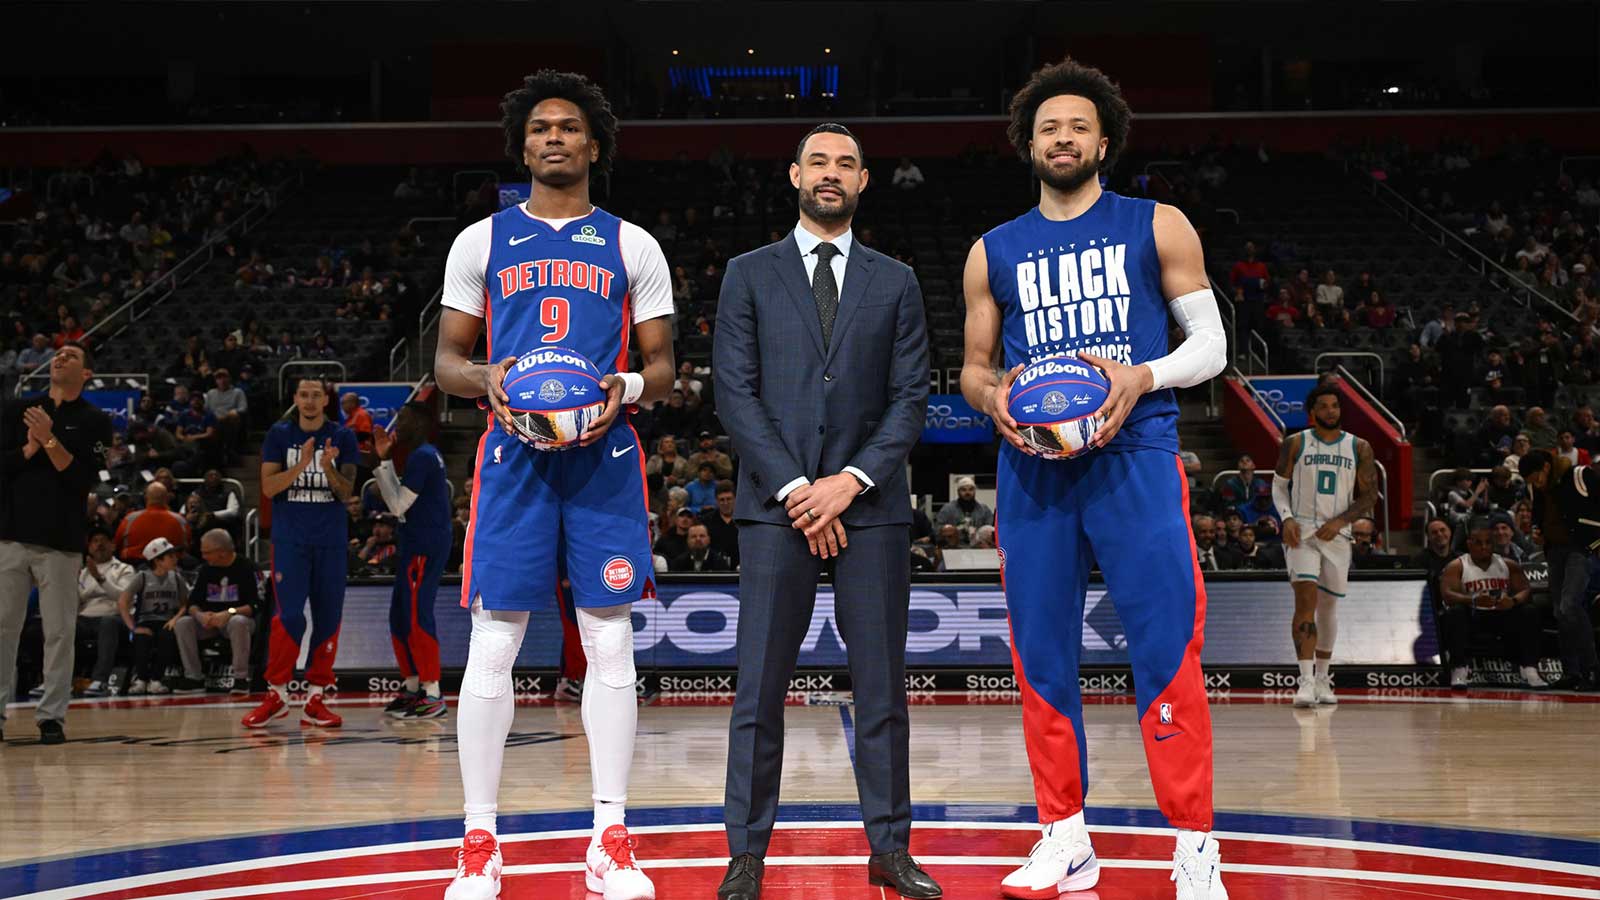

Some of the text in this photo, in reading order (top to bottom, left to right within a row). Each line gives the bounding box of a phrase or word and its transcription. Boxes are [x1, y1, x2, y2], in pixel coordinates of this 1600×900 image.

[1027, 237, 1108, 258] BUILT BY
[497, 259, 614, 299] DETROIT
[1017, 244, 1131, 312] BLACK
[540, 296, 570, 343] 9
[1025, 297, 1130, 347] HISTORY
[1028, 337, 1101, 355] ELEVATED
[517, 351, 588, 372] Wilson
[1020, 362, 1090, 386] Wilson
[926, 416, 989, 430] WORK
[287, 448, 336, 472] BAC
[1304, 454, 1352, 470] CHARLOTTE
[1318, 470, 1336, 495] 0
[1472, 658, 1513, 671] Little
[368, 677, 406, 691] Sto
[660, 677, 731, 690] StockX
[789, 675, 833, 689] ckX
[966, 675, 1017, 689] Stoc
[1079, 674, 1127, 689] ockX
[1367, 672, 1440, 687] StockX
[1467, 671, 1521, 683] aesars
